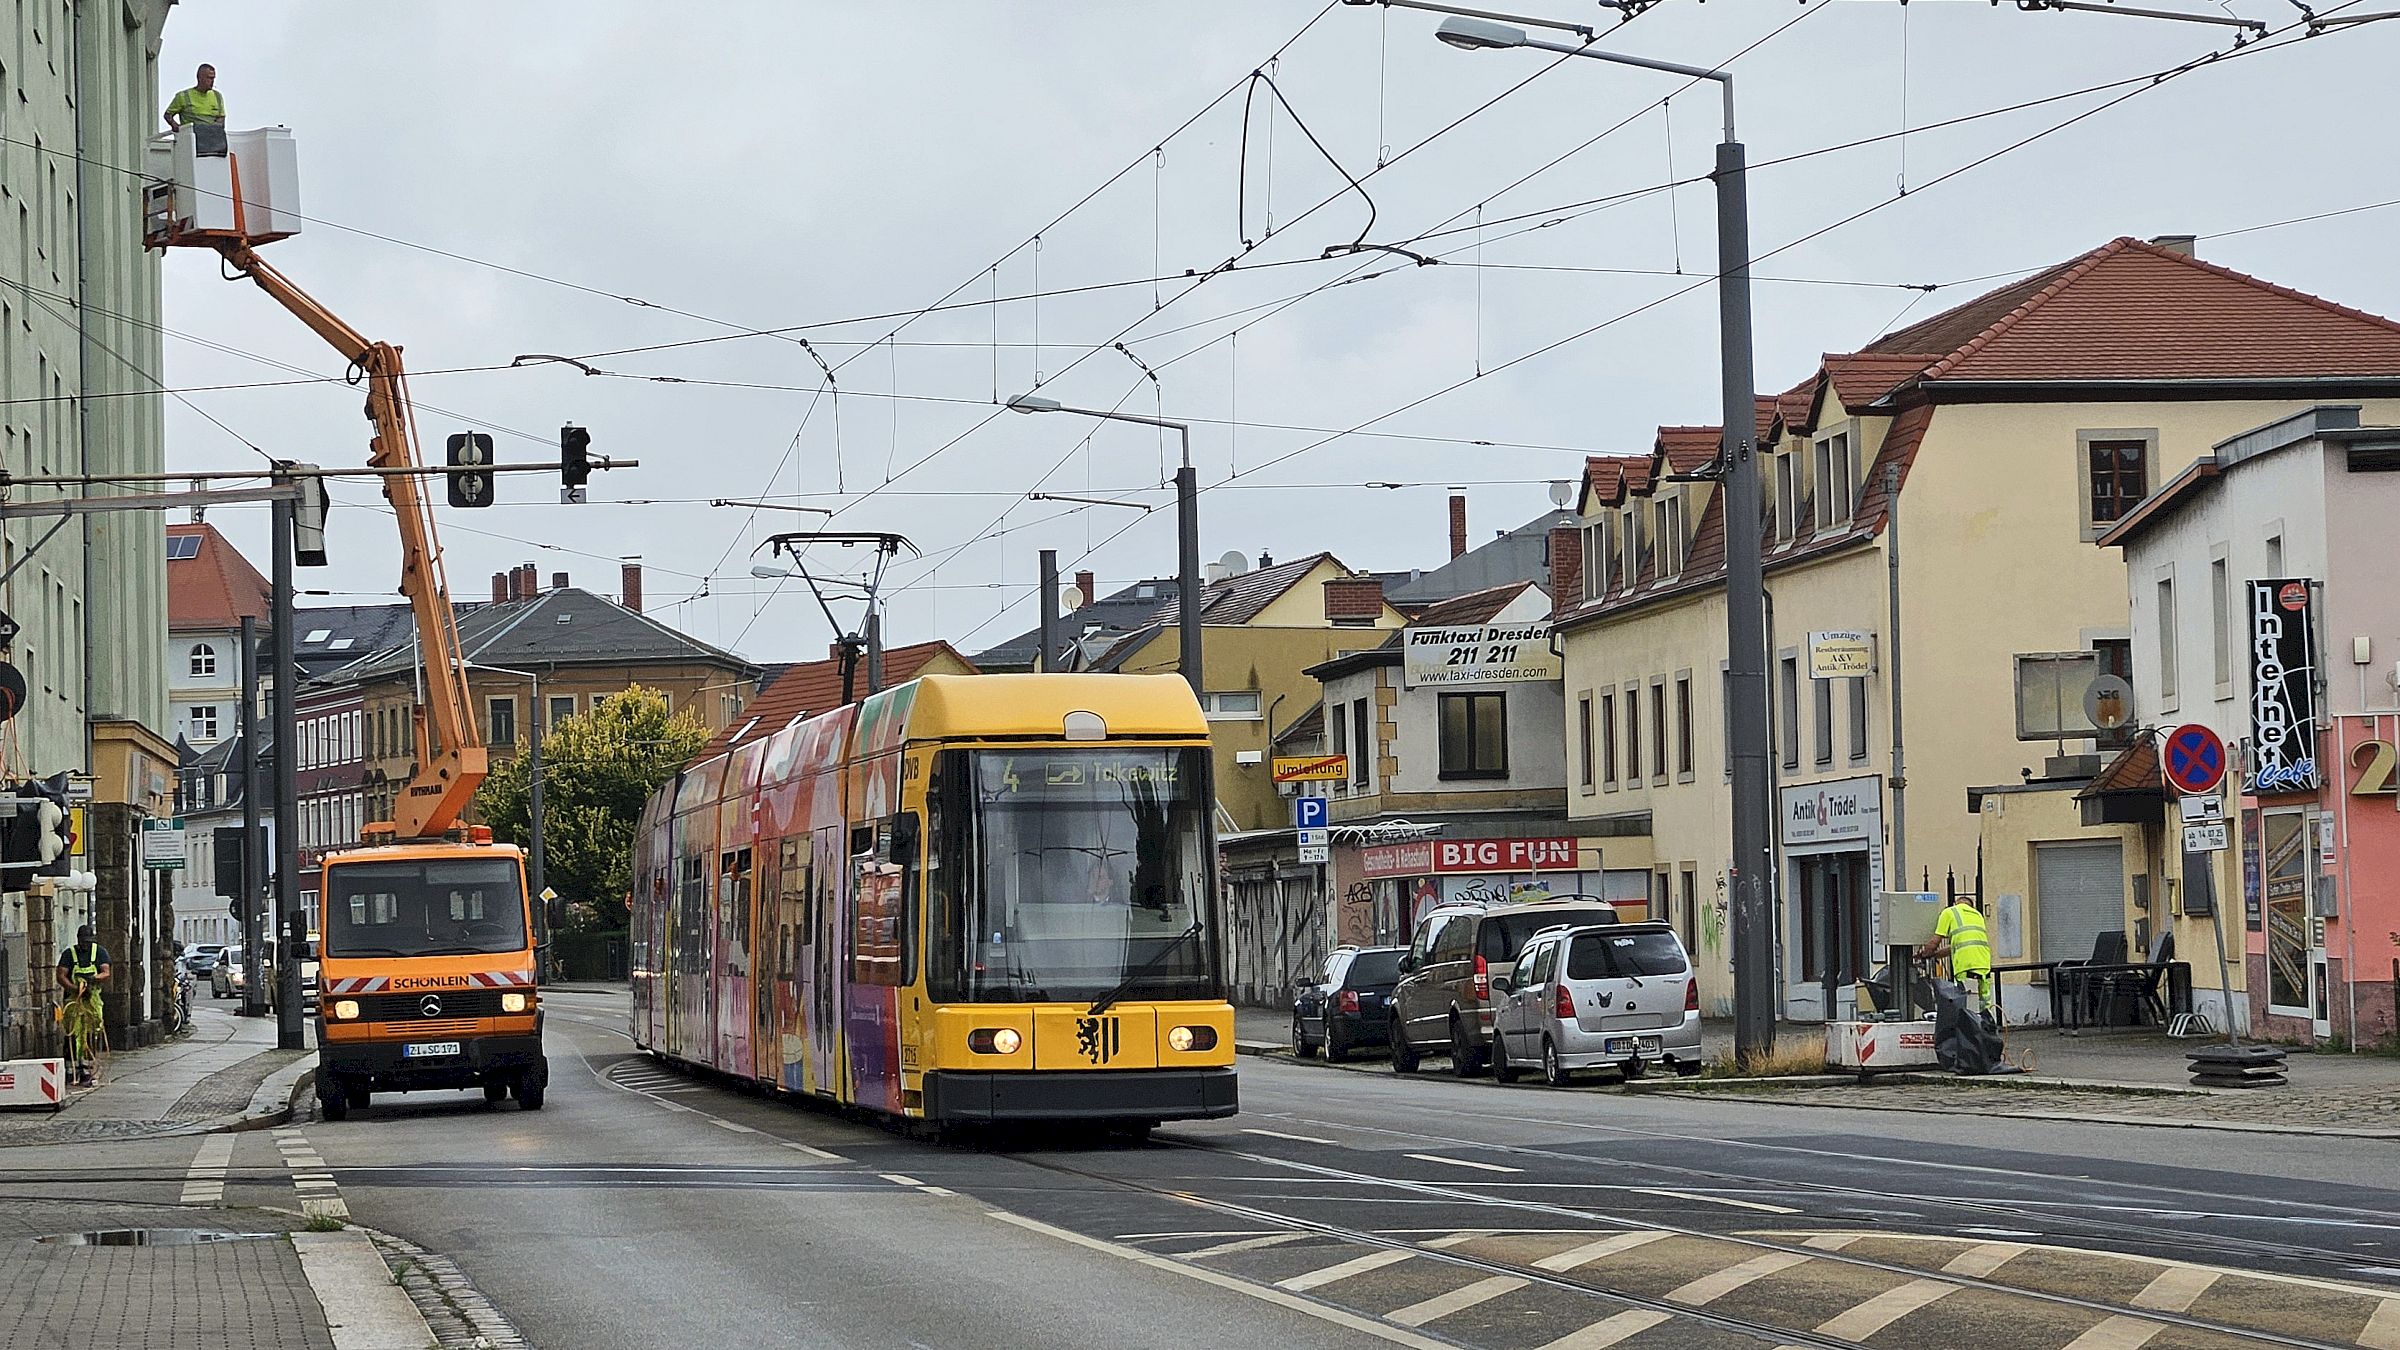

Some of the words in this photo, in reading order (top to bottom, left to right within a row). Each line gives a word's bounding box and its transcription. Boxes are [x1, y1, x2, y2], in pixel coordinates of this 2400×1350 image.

[1410, 628, 1484, 646] Funktaxi
[1447, 646, 1479, 666] 211
[1486, 645, 1518, 664] 211
[1830, 654, 1853, 662] A&V
[1420, 666, 1548, 682] www.taxi-dresden.com
[2255, 587, 2285, 769] Internet
[1002, 758, 1020, 793] 4
[1277, 763, 1343, 776] Umleitung
[2256, 758, 2315, 788] Café
[1303, 802, 1320, 825] P
[1792, 800, 1816, 820] Antik
[1817, 791, 1828, 826] &
[1828, 794, 1856, 816] Trödel
[1442, 842, 1498, 866] BIG
[1510, 841, 1569, 864] FUN
[394, 974, 470, 989] SCHÖNLEIN
